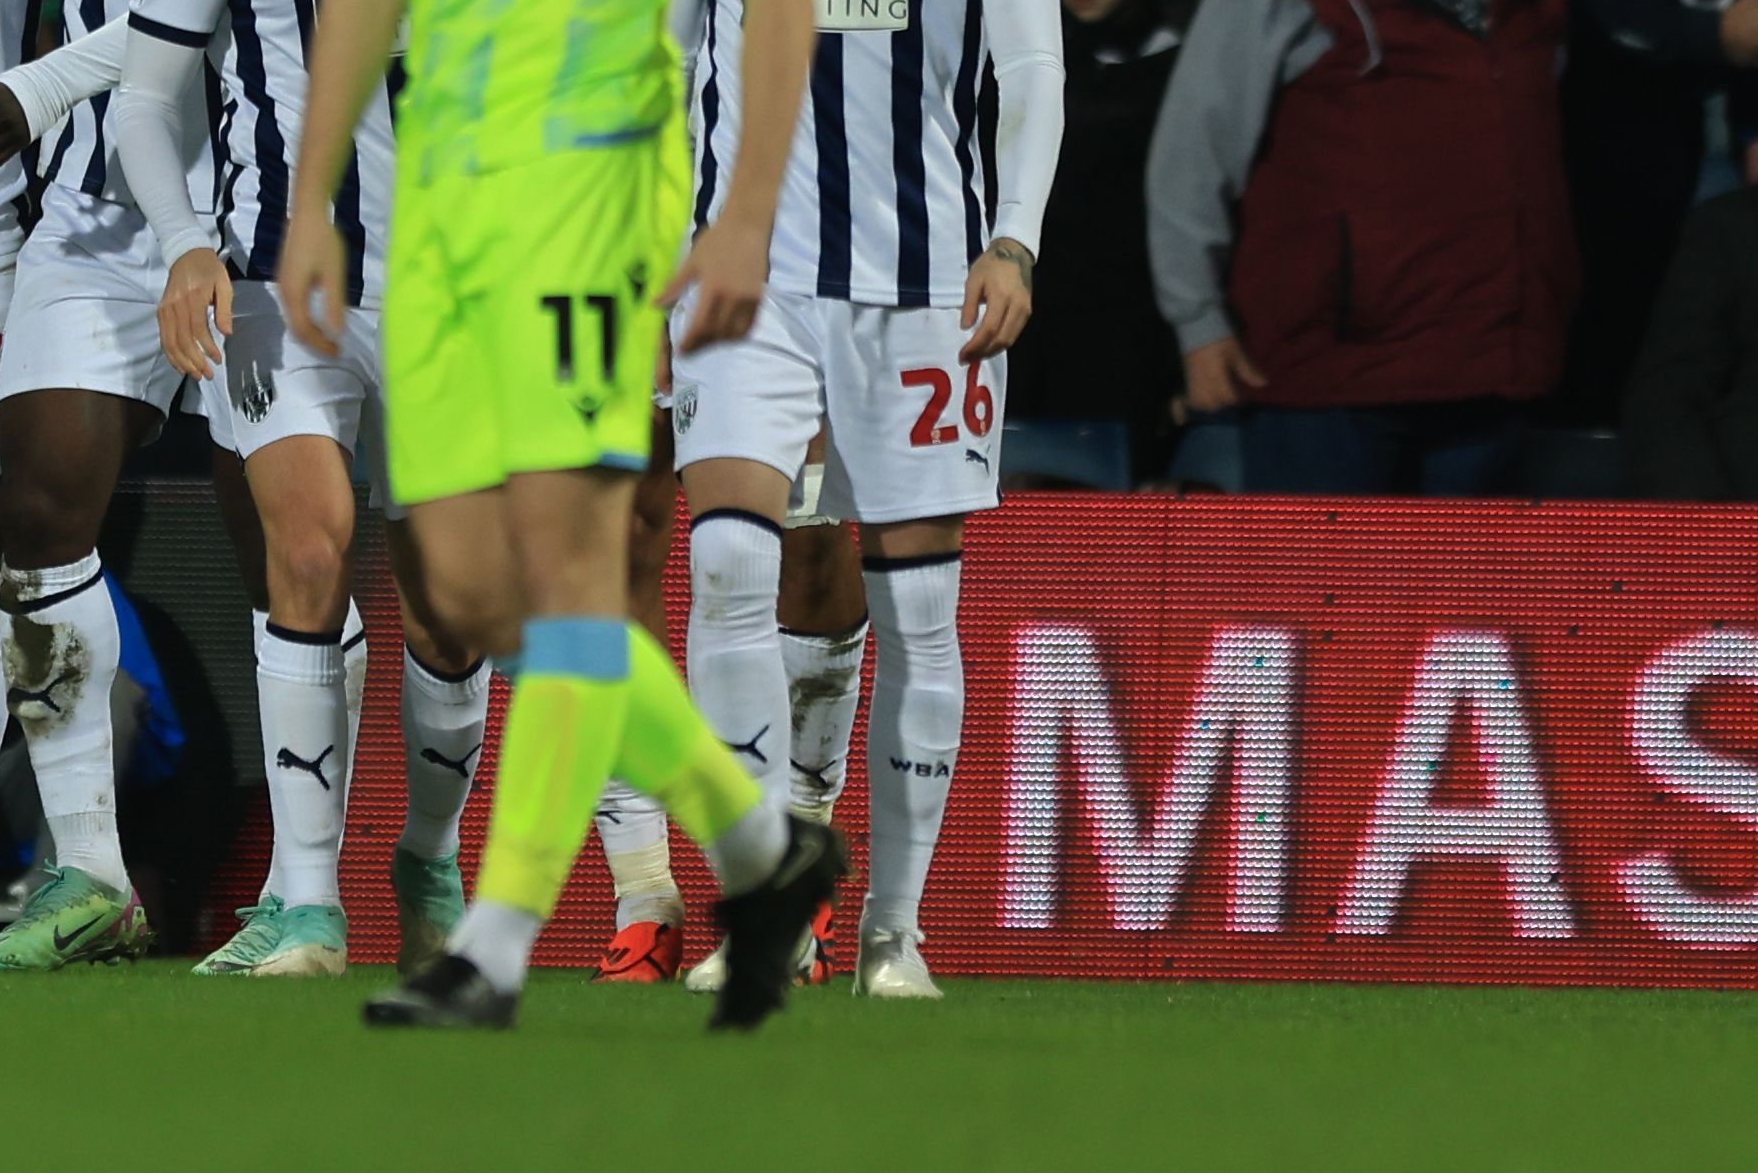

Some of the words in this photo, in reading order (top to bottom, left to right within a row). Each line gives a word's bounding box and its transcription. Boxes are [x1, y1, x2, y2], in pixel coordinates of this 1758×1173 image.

[539, 294, 618, 384] 11
[900, 358, 994, 448] 26
[889, 756, 950, 779] WBA
[996, 623, 1758, 949] MAS
